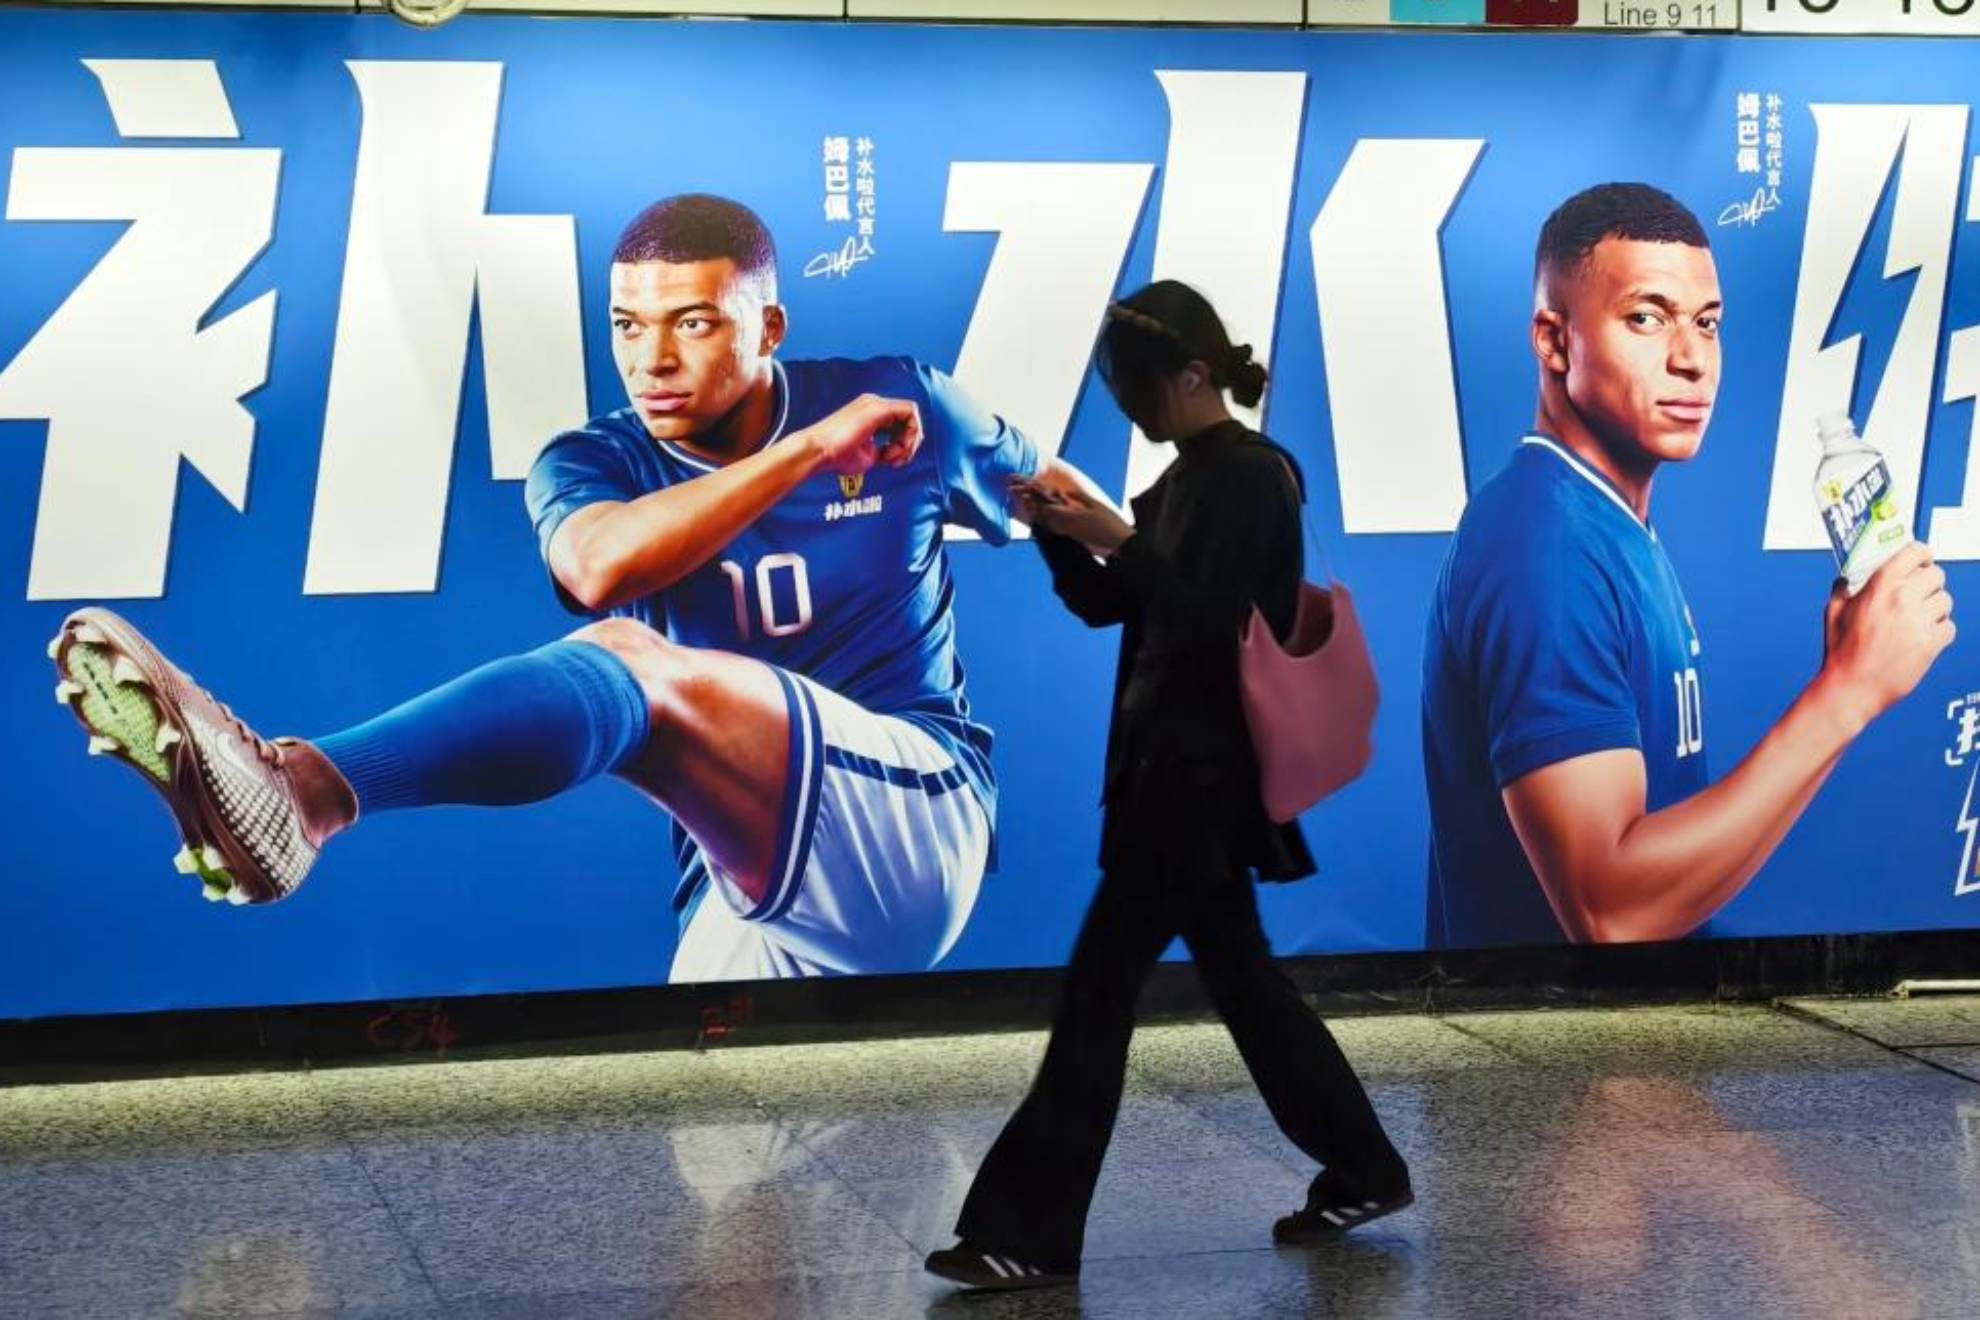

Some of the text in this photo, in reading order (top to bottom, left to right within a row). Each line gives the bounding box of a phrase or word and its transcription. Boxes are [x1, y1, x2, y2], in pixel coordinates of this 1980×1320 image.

[1603, 1, 1716, 27] Line 9 11
[1737, 92, 1761, 173] 姆巴佩
[823, 136, 851, 222] 姆巴佩
[720, 552, 813, 641] 10
[1673, 667, 1703, 759] 10
